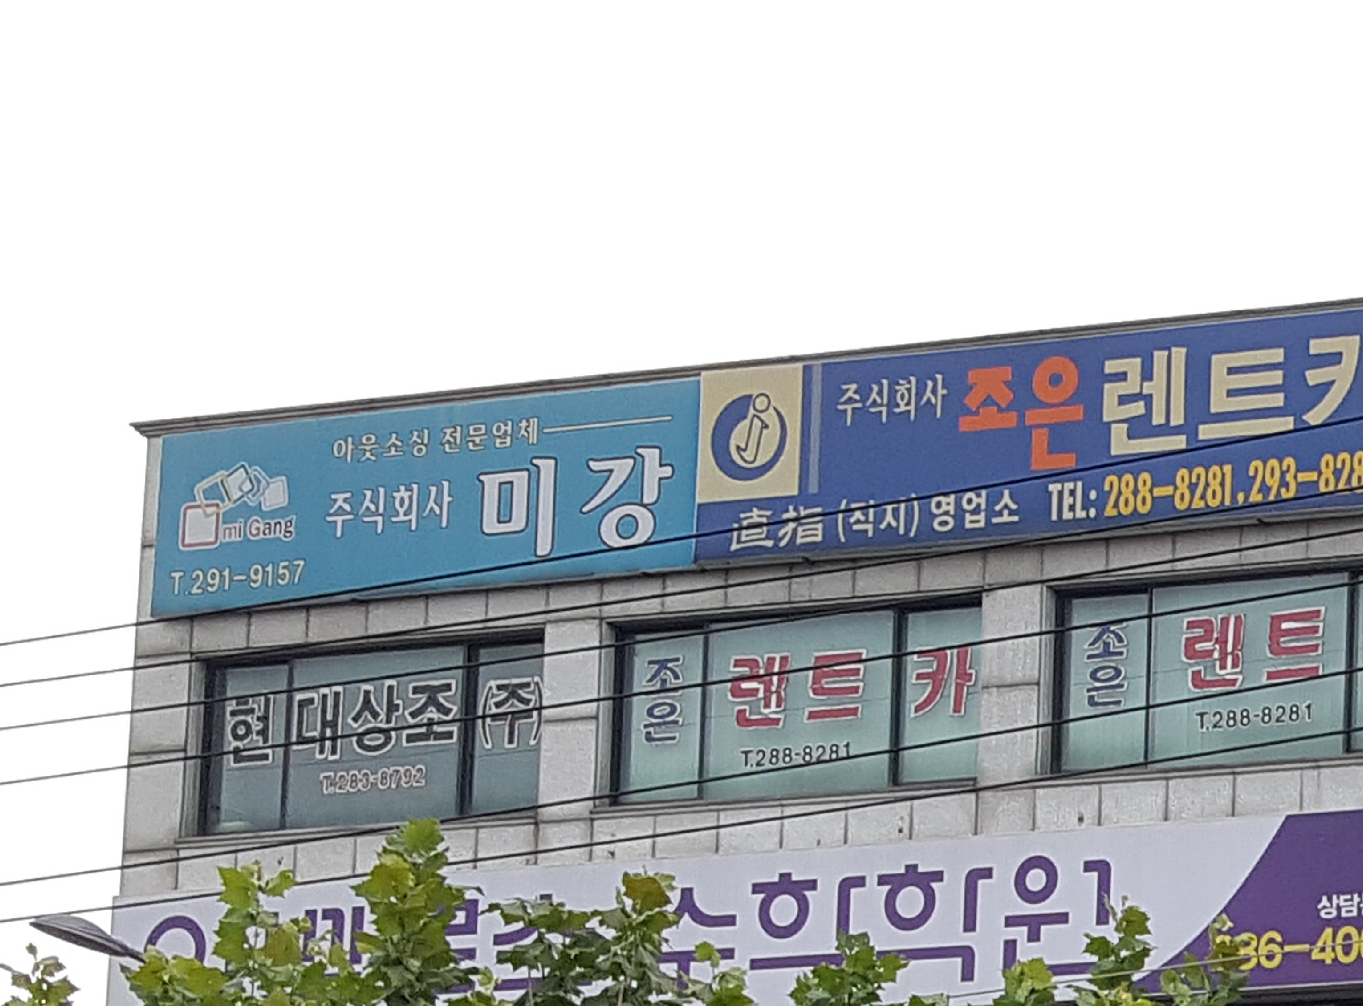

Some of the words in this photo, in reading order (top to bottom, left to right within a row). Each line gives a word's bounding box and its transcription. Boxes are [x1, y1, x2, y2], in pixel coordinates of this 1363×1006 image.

[836, 373, 948, 428] 주식회사
[333, 429, 428, 463] 아웃소싱
[440, 418, 540, 454] 전문업체
[325, 480, 453, 537] 주식회사
[478, 446, 675, 558] 미강
[930, 490, 1019, 532] 영업소
[222, 520, 243, 541] mi
[247, 515, 296, 541] Gang
[170, 560, 305, 595] T.291-9157
[727, 644, 975, 732] 렌트카
[228, 678, 457, 767] 현대상조
[478, 676, 543, 749] (주)
